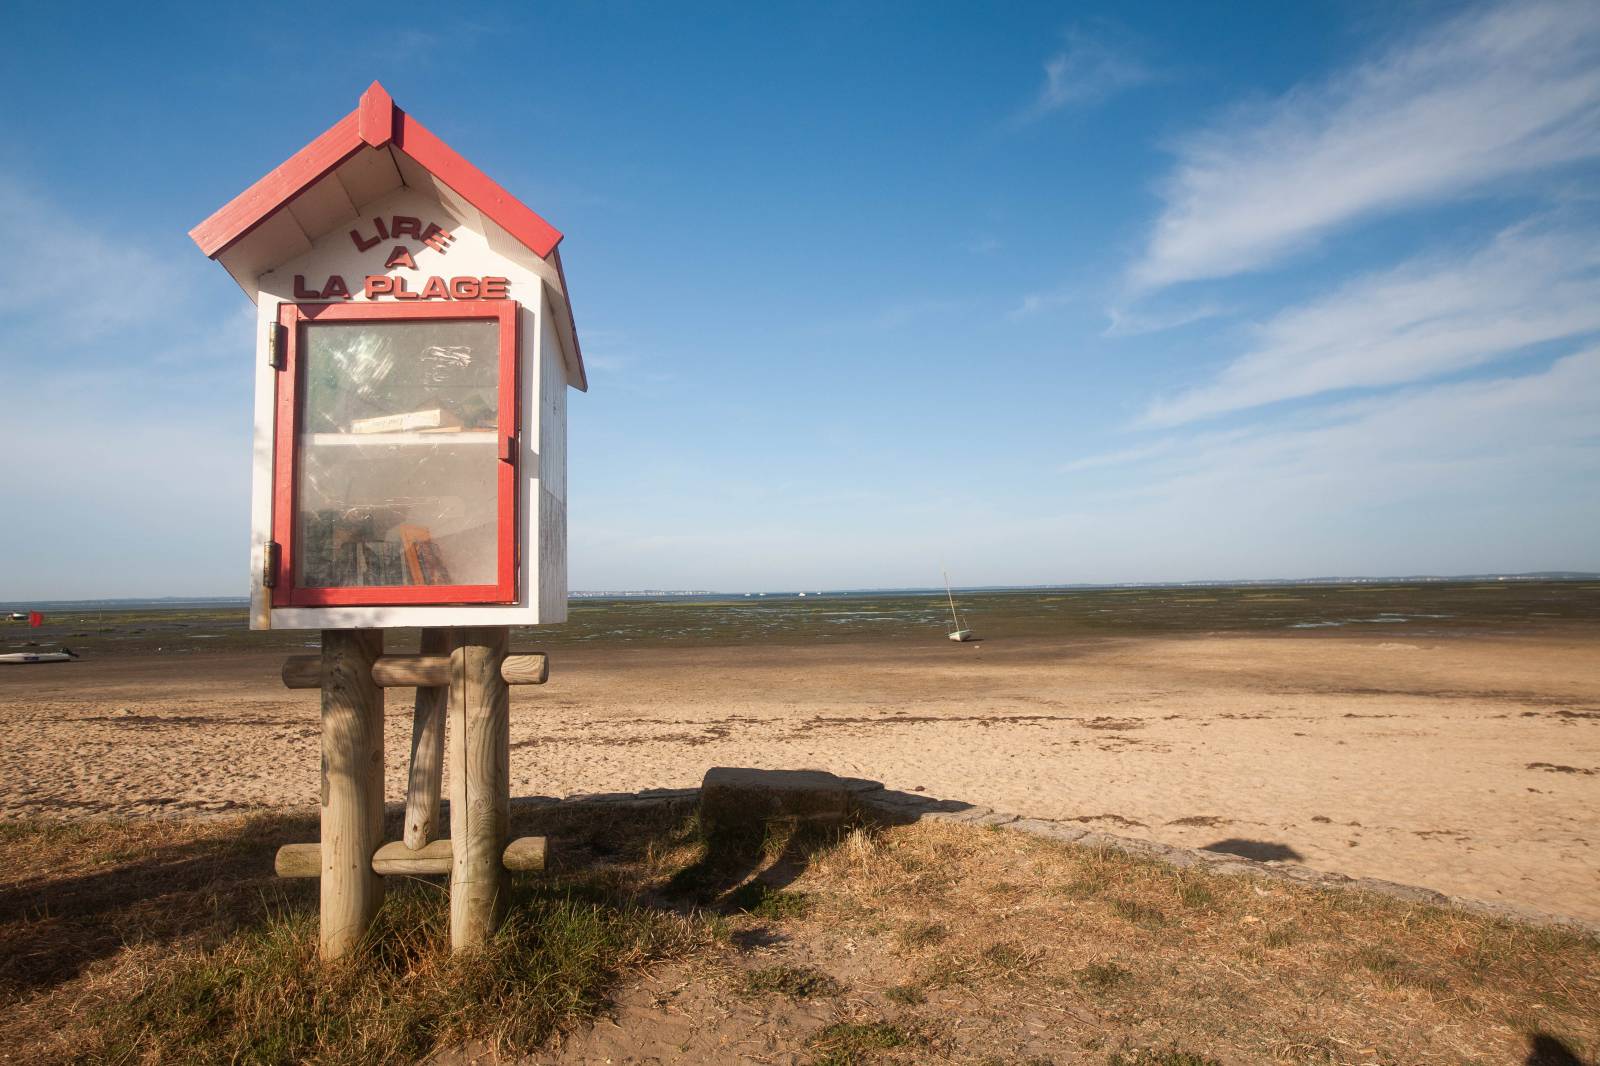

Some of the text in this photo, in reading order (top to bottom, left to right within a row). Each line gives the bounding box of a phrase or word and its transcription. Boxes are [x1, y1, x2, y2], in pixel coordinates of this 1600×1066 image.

[350, 216, 456, 255] LIRE
[385, 246, 418, 270] A
[294, 275, 510, 300] LA PLAGE
